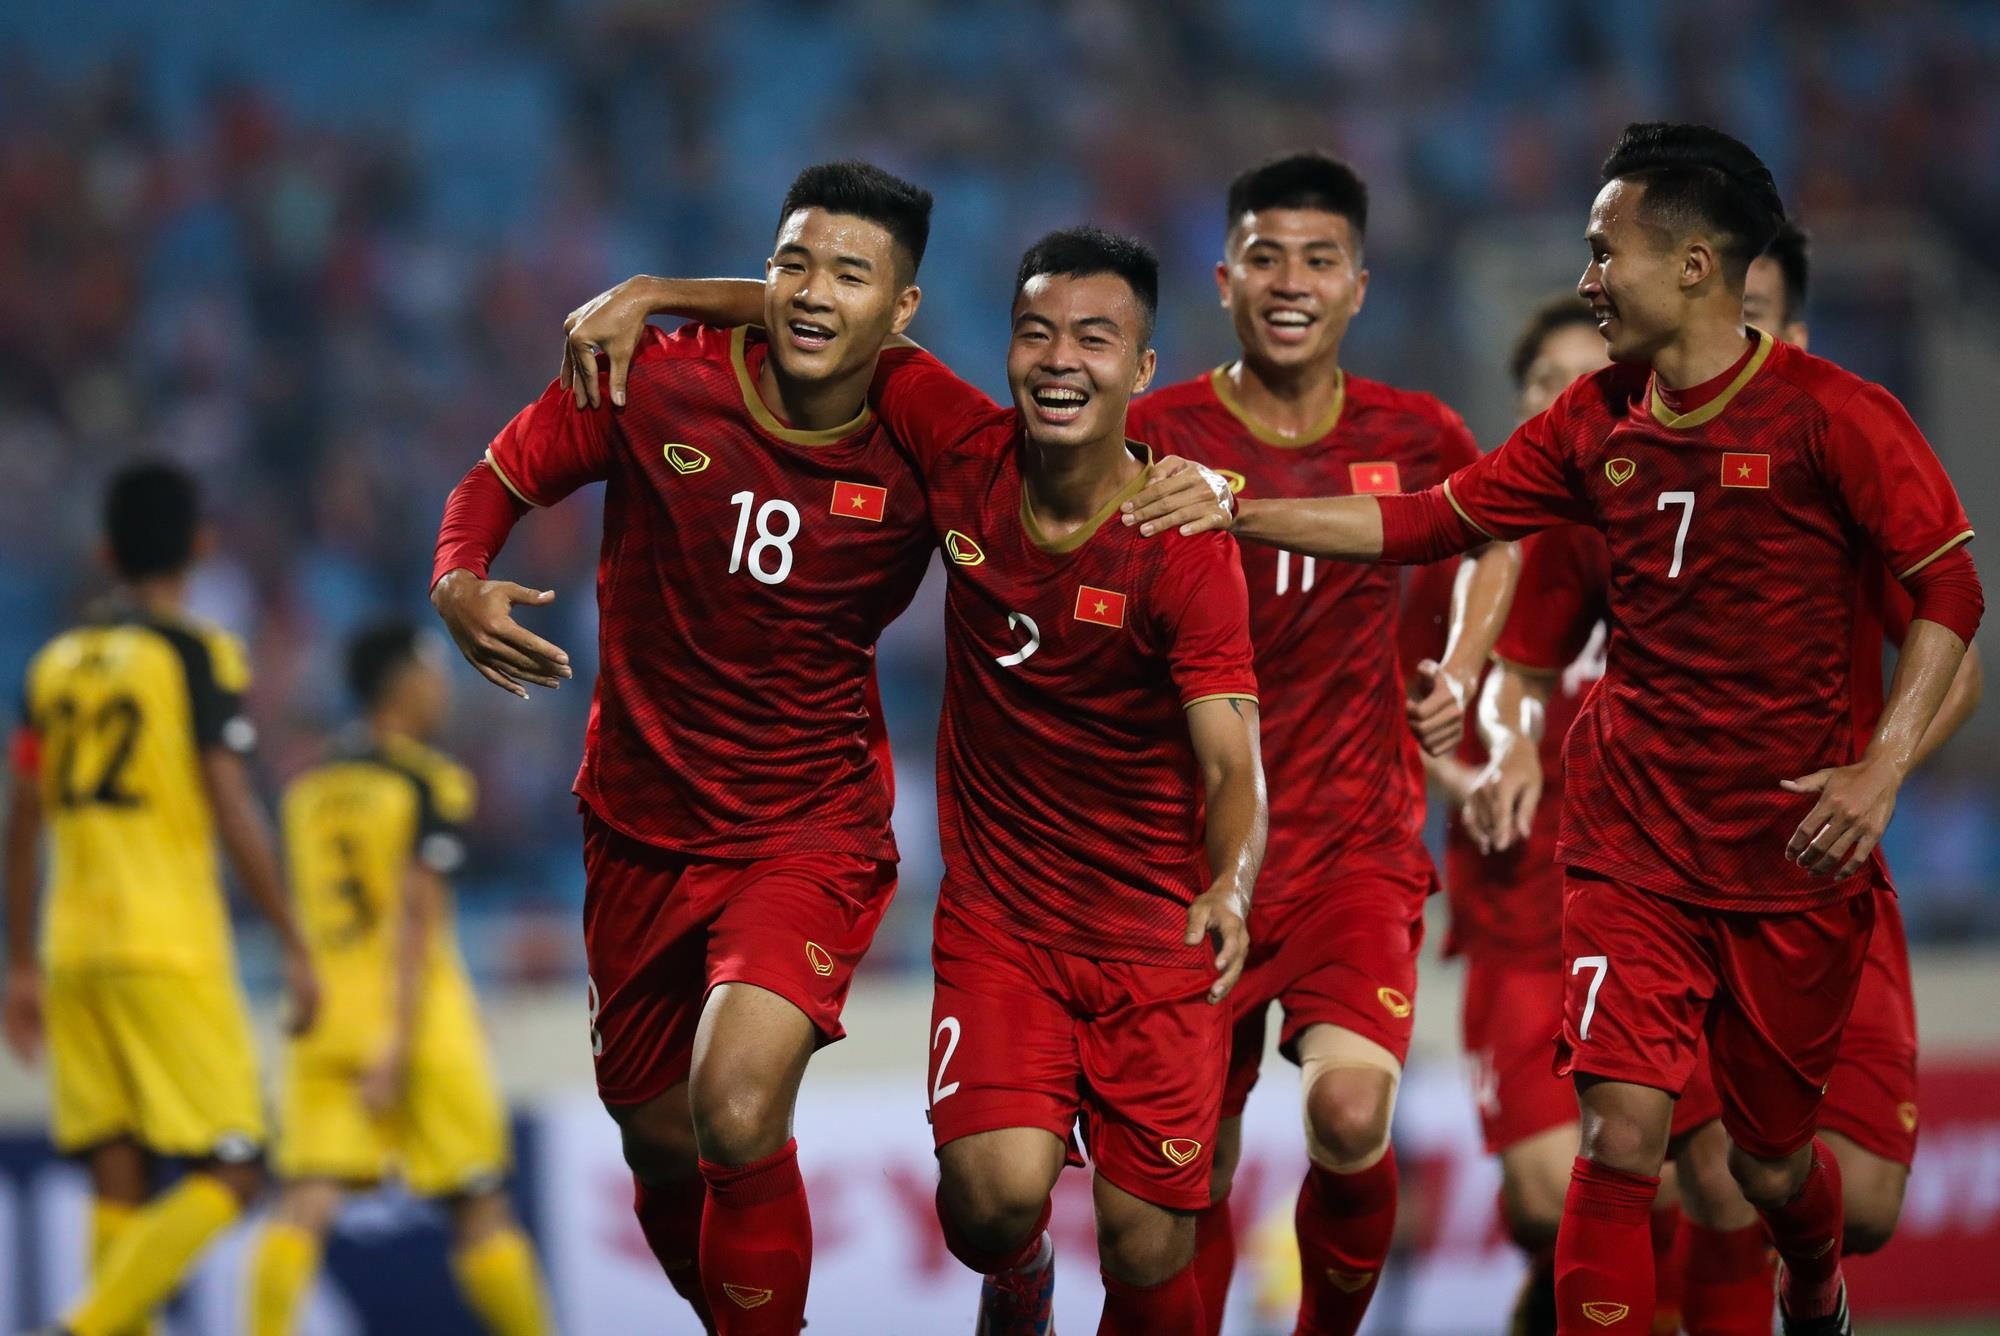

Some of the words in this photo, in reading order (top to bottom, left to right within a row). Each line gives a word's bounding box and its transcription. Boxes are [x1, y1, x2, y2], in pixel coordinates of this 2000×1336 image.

[729, 491, 800, 584] 18
[1657, 491, 1695, 577] 7
[1572, 956, 1608, 1040] 7
[933, 1016, 960, 1105] 2
